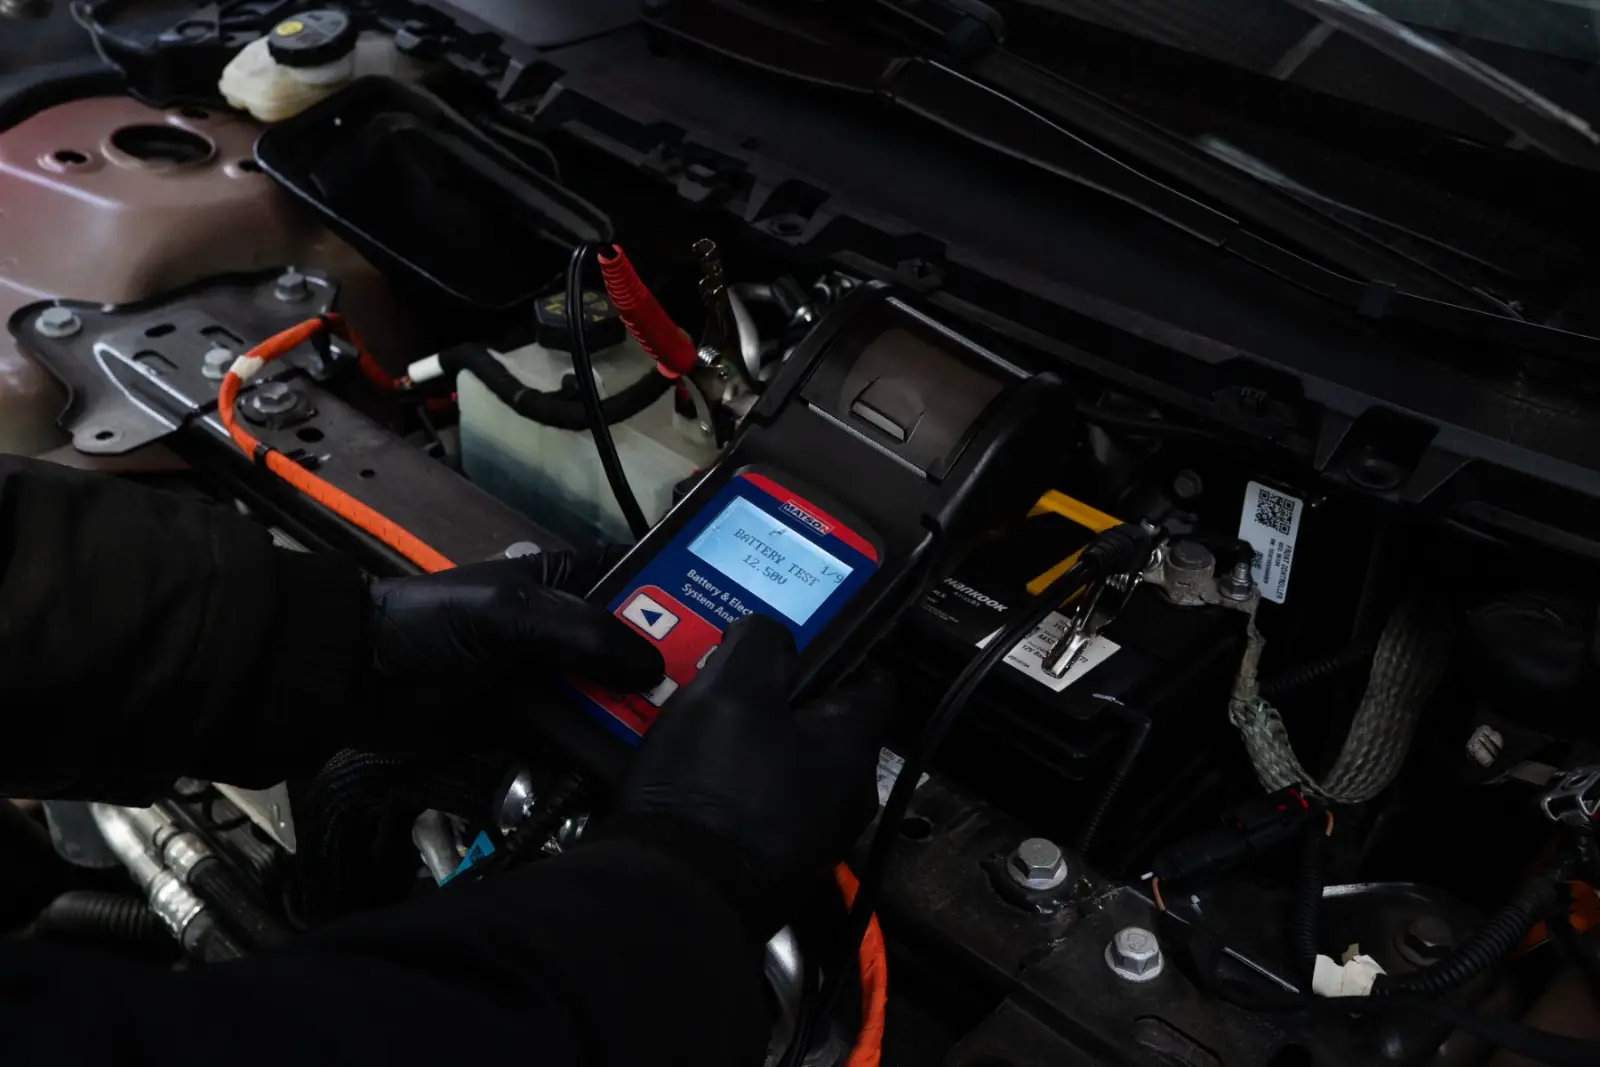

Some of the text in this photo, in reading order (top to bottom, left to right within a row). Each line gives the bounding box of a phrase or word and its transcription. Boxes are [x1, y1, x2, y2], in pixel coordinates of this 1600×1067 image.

[781, 503, 831, 534] MATSON
[733, 528, 821, 587] BATTERY TEST
[742, 554, 788, 585] 12.50V
[686, 569, 721, 597] Battery
[720, 591, 730, 602] &
[820, 564, 844, 584] 1/9
[681, 583, 715, 615] System
